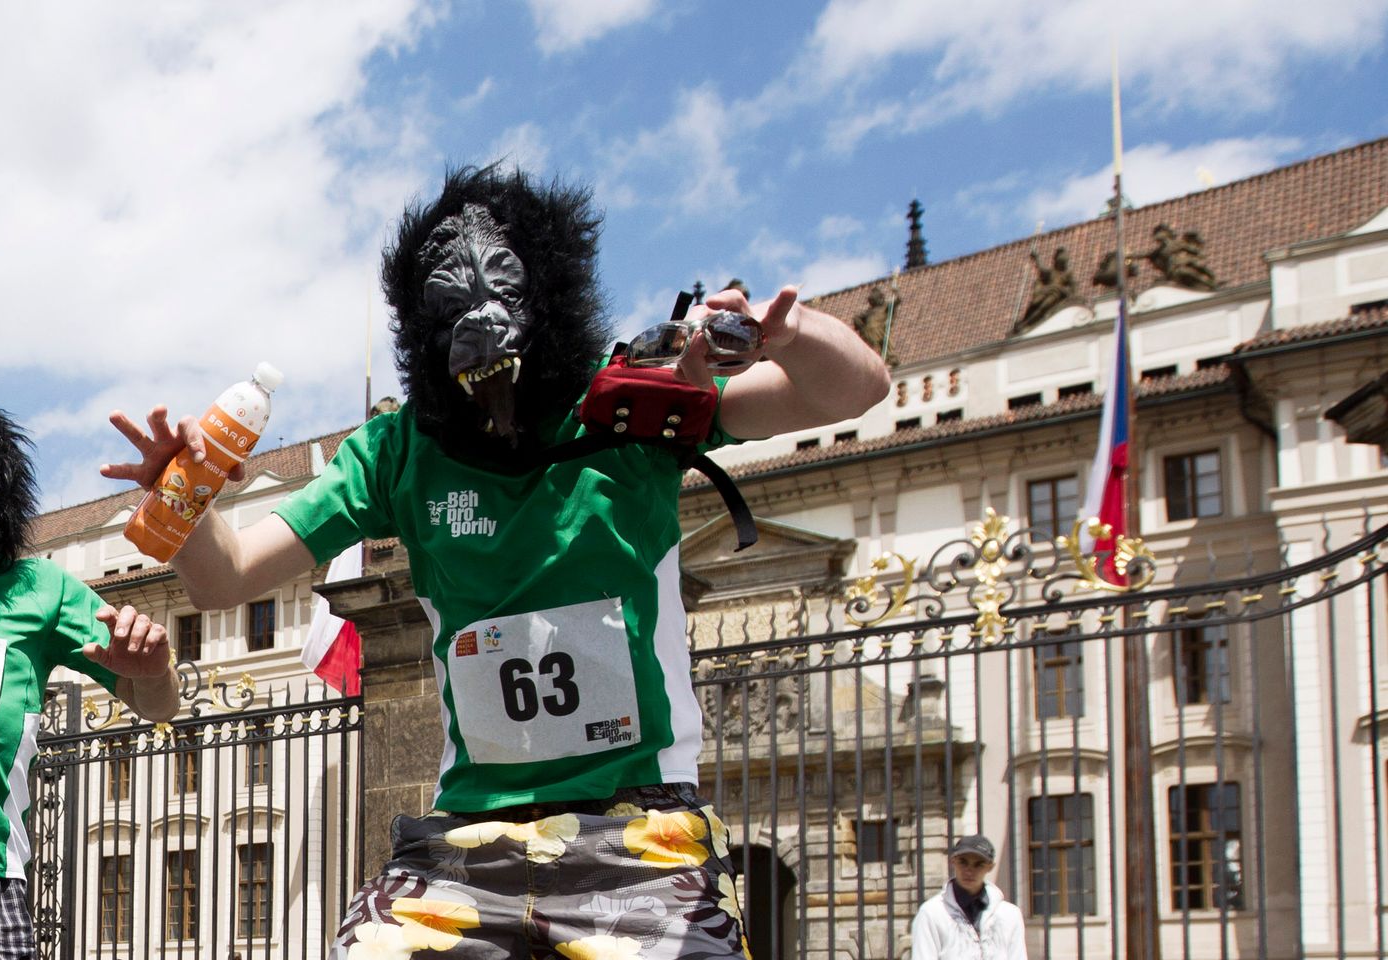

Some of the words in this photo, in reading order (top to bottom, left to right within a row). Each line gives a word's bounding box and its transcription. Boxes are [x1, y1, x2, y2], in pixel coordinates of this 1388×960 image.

[208, 414, 238, 441] SPAR
[447, 489, 479, 508] Běh
[446, 507, 474, 525] pro
[450, 516, 497, 538] gorily
[499, 651, 580, 722] 63
